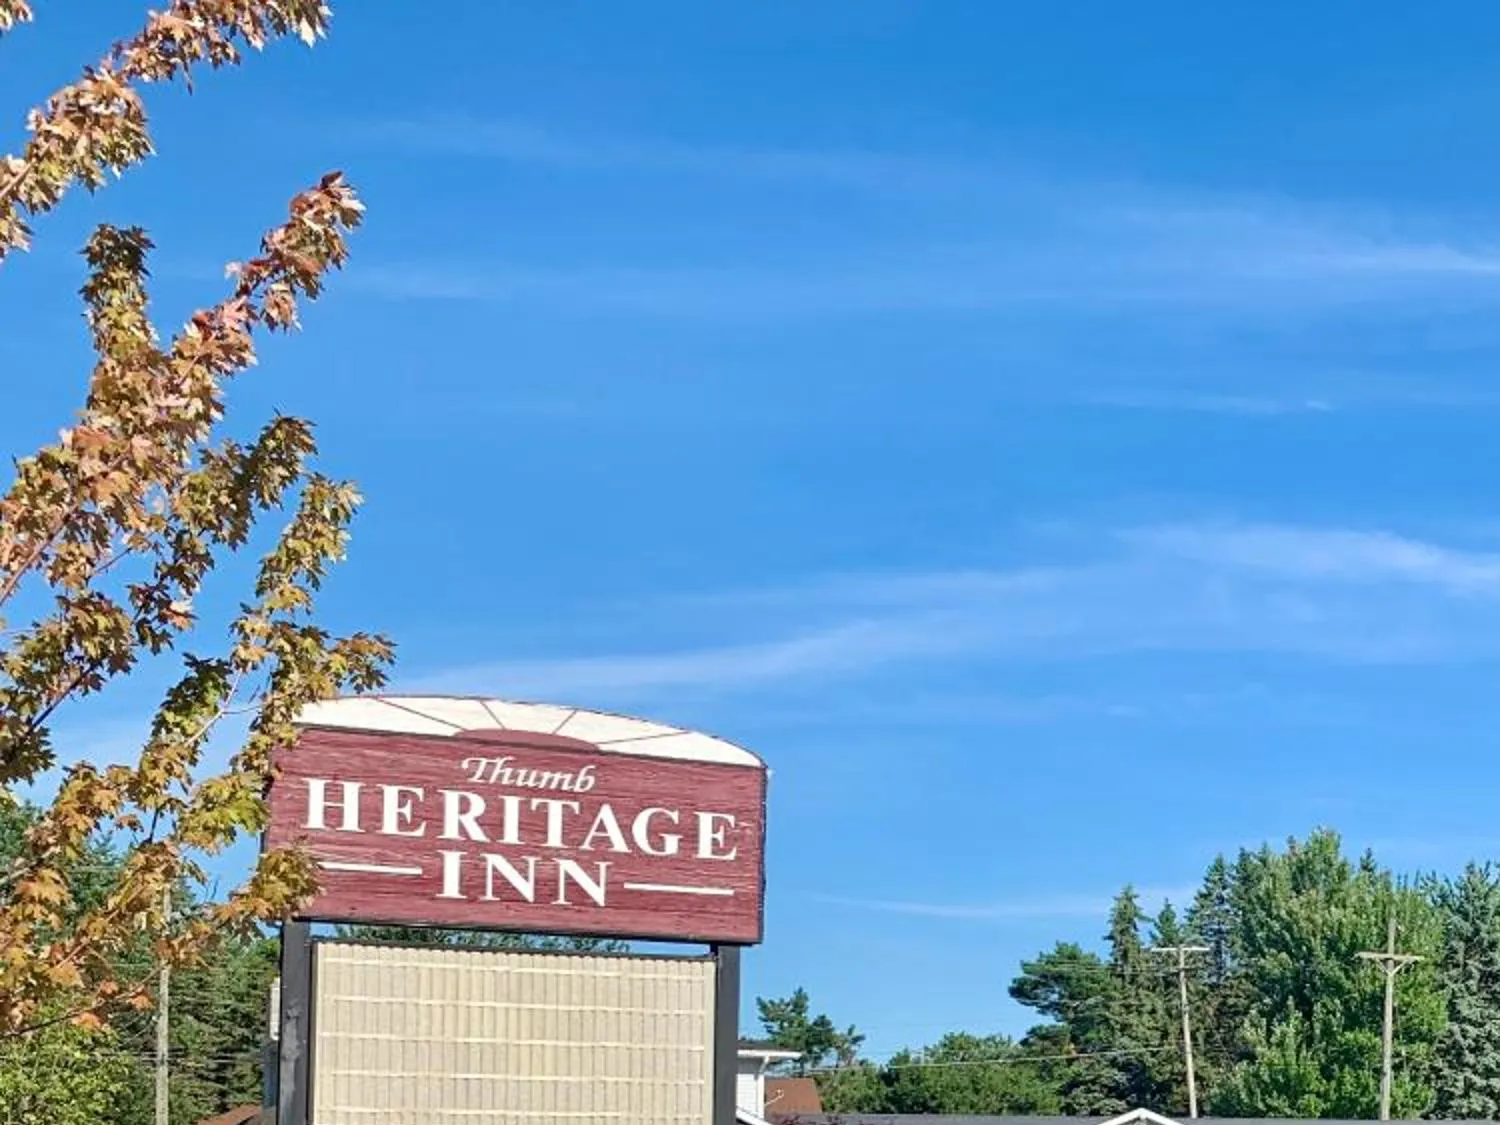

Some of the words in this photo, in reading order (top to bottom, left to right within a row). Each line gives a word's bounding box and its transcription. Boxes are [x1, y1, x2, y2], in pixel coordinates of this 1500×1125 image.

[461, 756, 596, 793] Thumb
[301, 777, 738, 861] HERITAGE
[436, 850, 613, 907] INN
